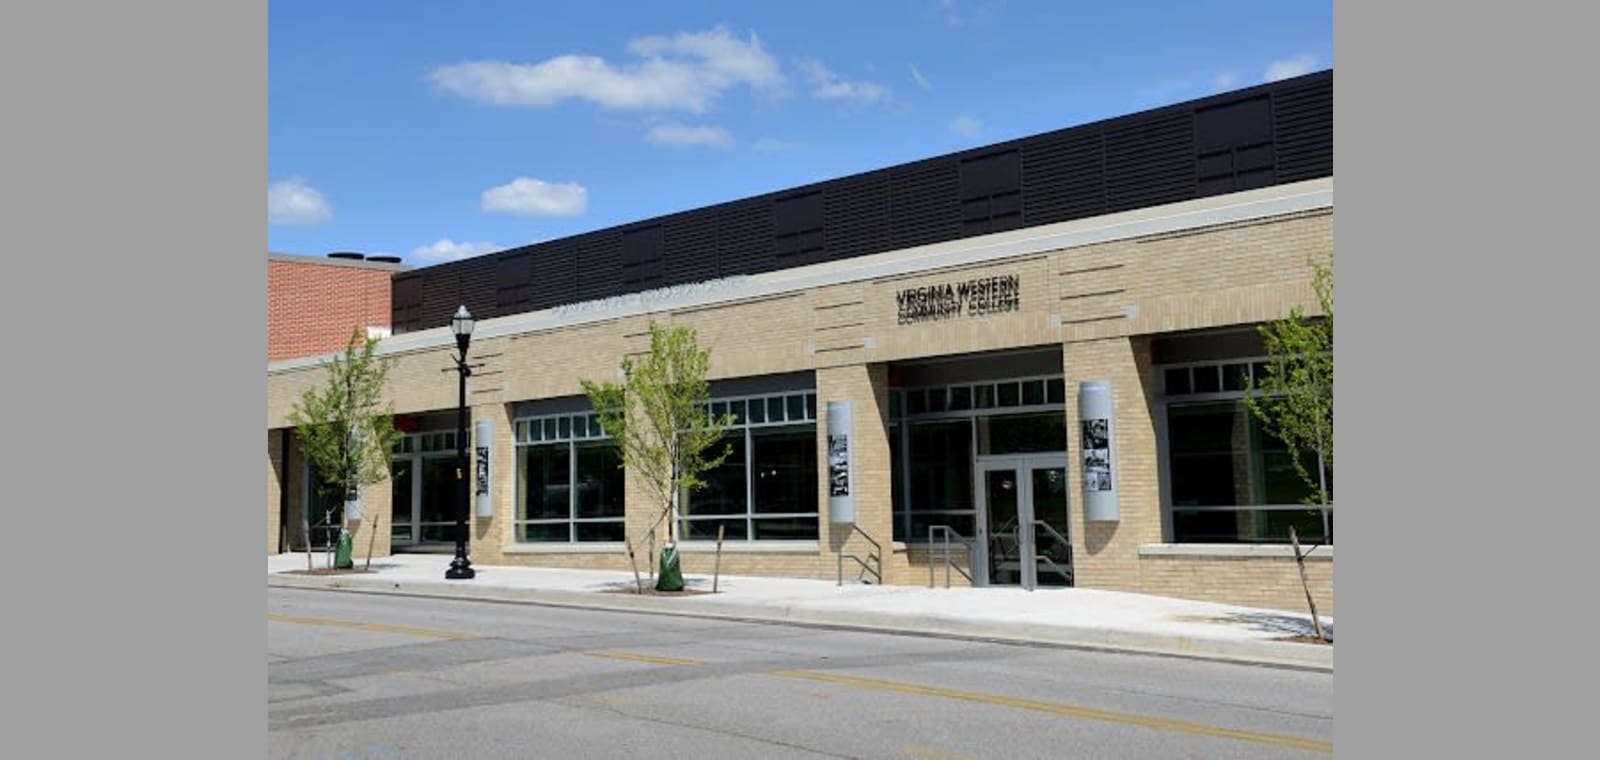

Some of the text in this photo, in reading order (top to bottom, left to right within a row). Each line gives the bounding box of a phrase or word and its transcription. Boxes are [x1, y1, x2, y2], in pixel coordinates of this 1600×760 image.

[896, 274, 1019, 304] VIRGINIA WESTERN
[898, 294, 1019, 324] COMMUNITY COLLEGE
